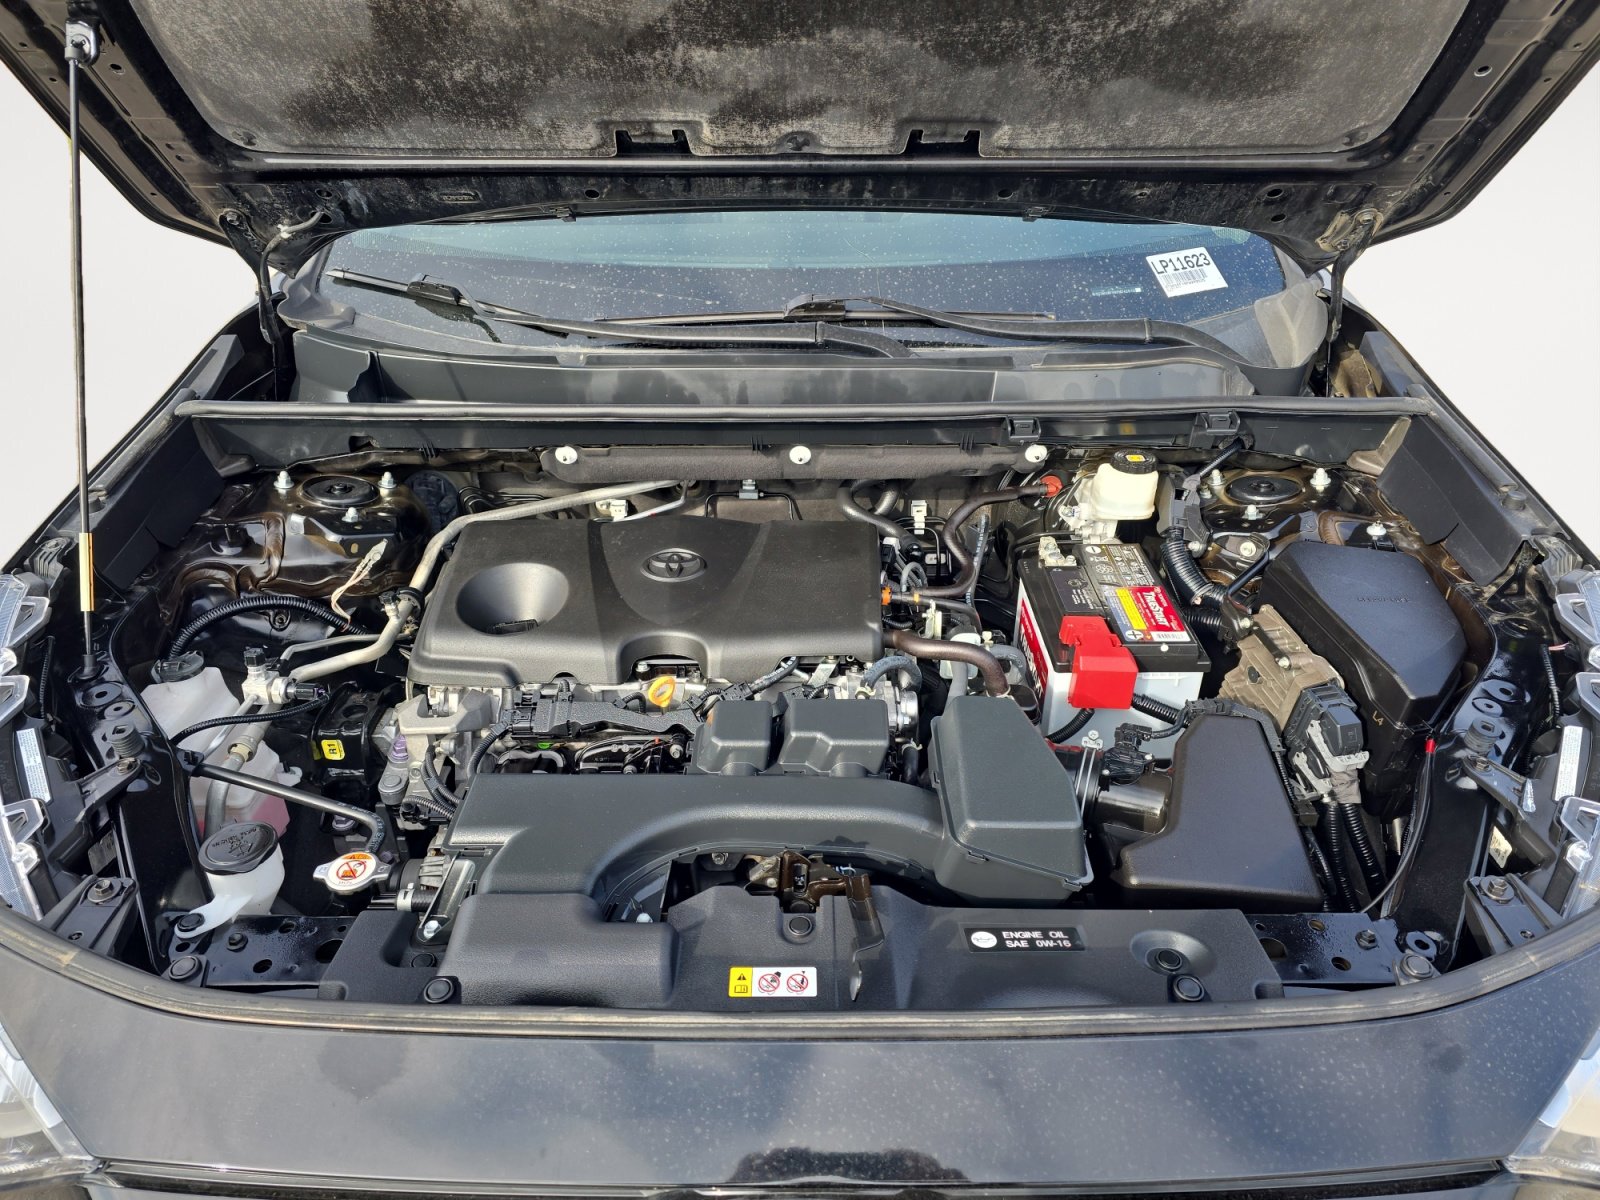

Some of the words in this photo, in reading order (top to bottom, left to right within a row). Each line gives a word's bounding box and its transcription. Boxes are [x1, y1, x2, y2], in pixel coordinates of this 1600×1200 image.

[1151, 252, 1211, 275] LP11623
[327, 743, 337, 755] R1
[1001, 931, 1043, 939] ENGINE
[1048, 931, 1069, 939] OIL
[1005, 940, 1030, 948] SAE
[1035, 940, 1072, 948] 0W-16
